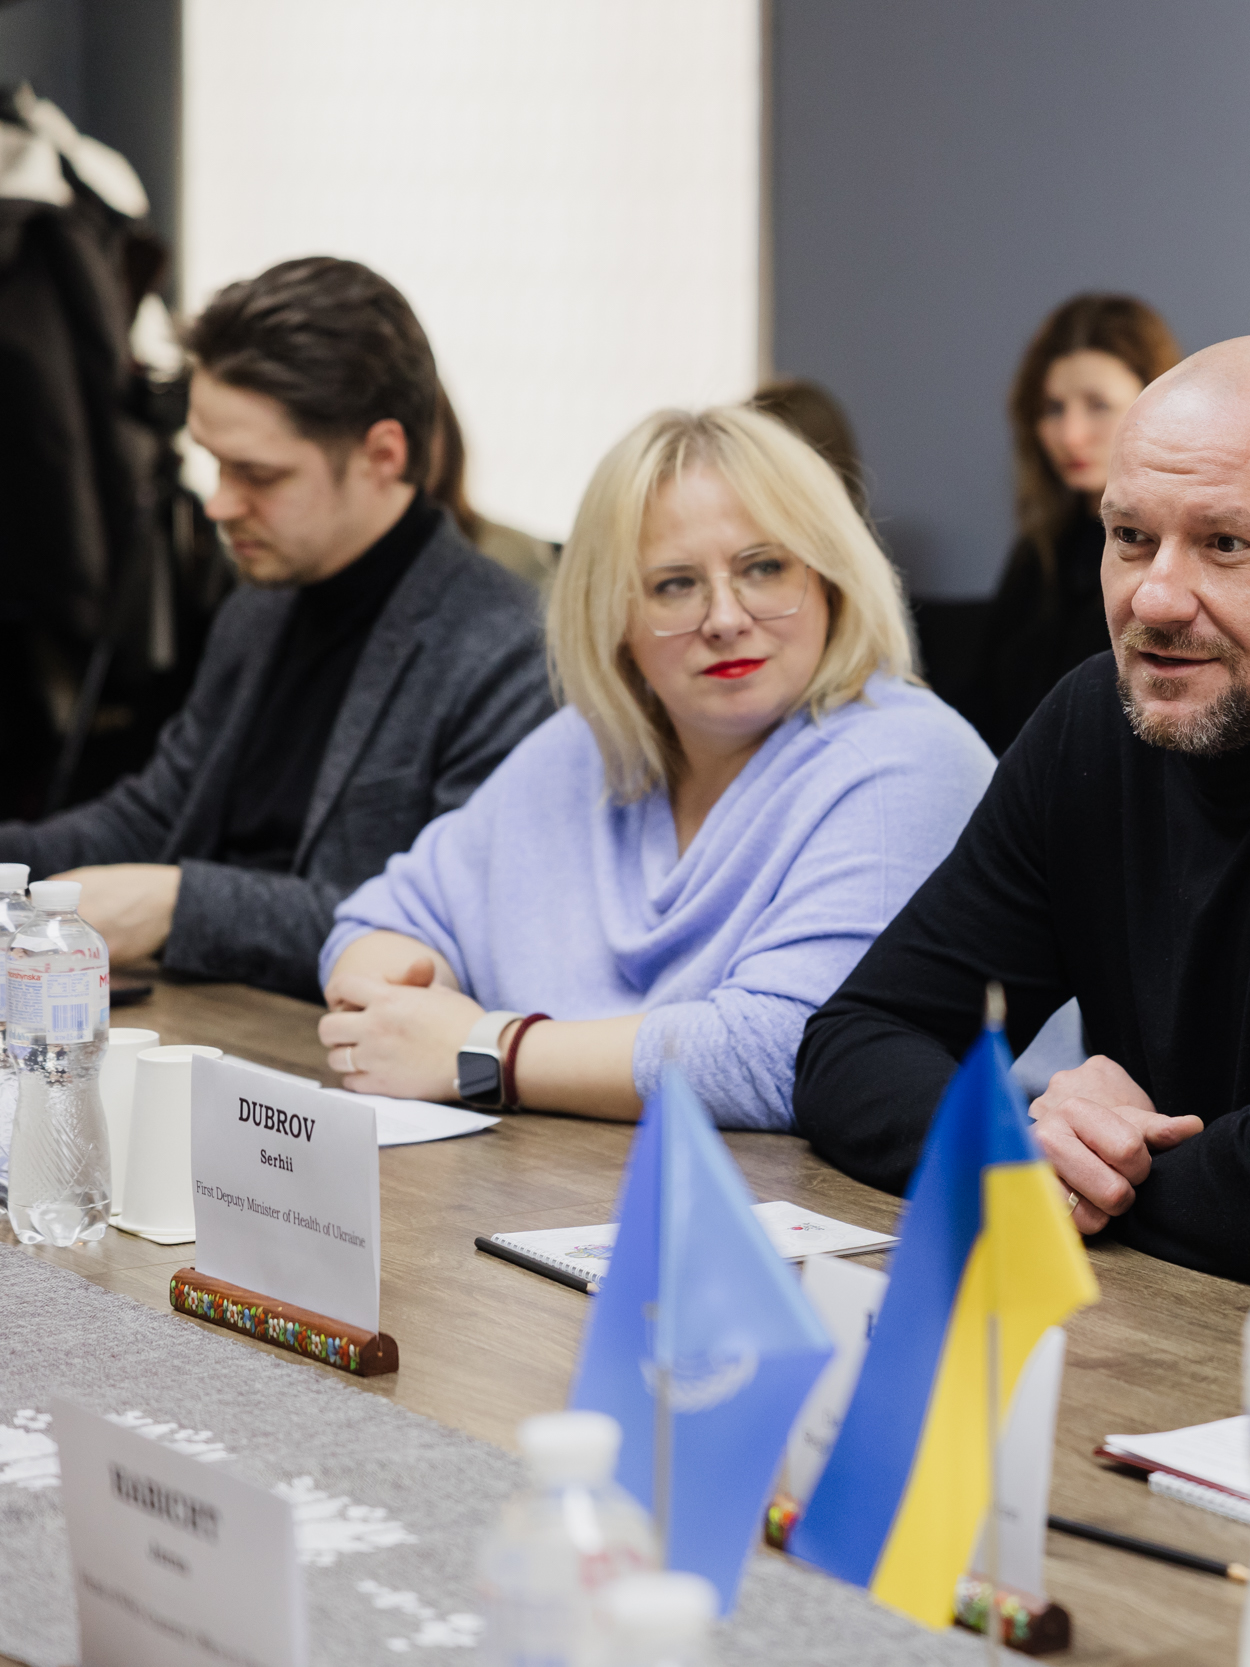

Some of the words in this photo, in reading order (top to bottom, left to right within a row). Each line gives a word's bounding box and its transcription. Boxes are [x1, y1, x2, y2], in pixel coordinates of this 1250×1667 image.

[238, 1096, 316, 1142] DUBROV
[260, 1148, 293, 1173] Serhii
[196, 1180, 215, 1199] First
[216, 1186, 245, 1212] Deputy
[247, 1196, 281, 1220] Minister
[282, 1209, 292, 1223] of
[293, 1211, 321, 1234] Health
[322, 1222, 331, 1237] of
[332, 1223, 366, 1249] Ukraine
